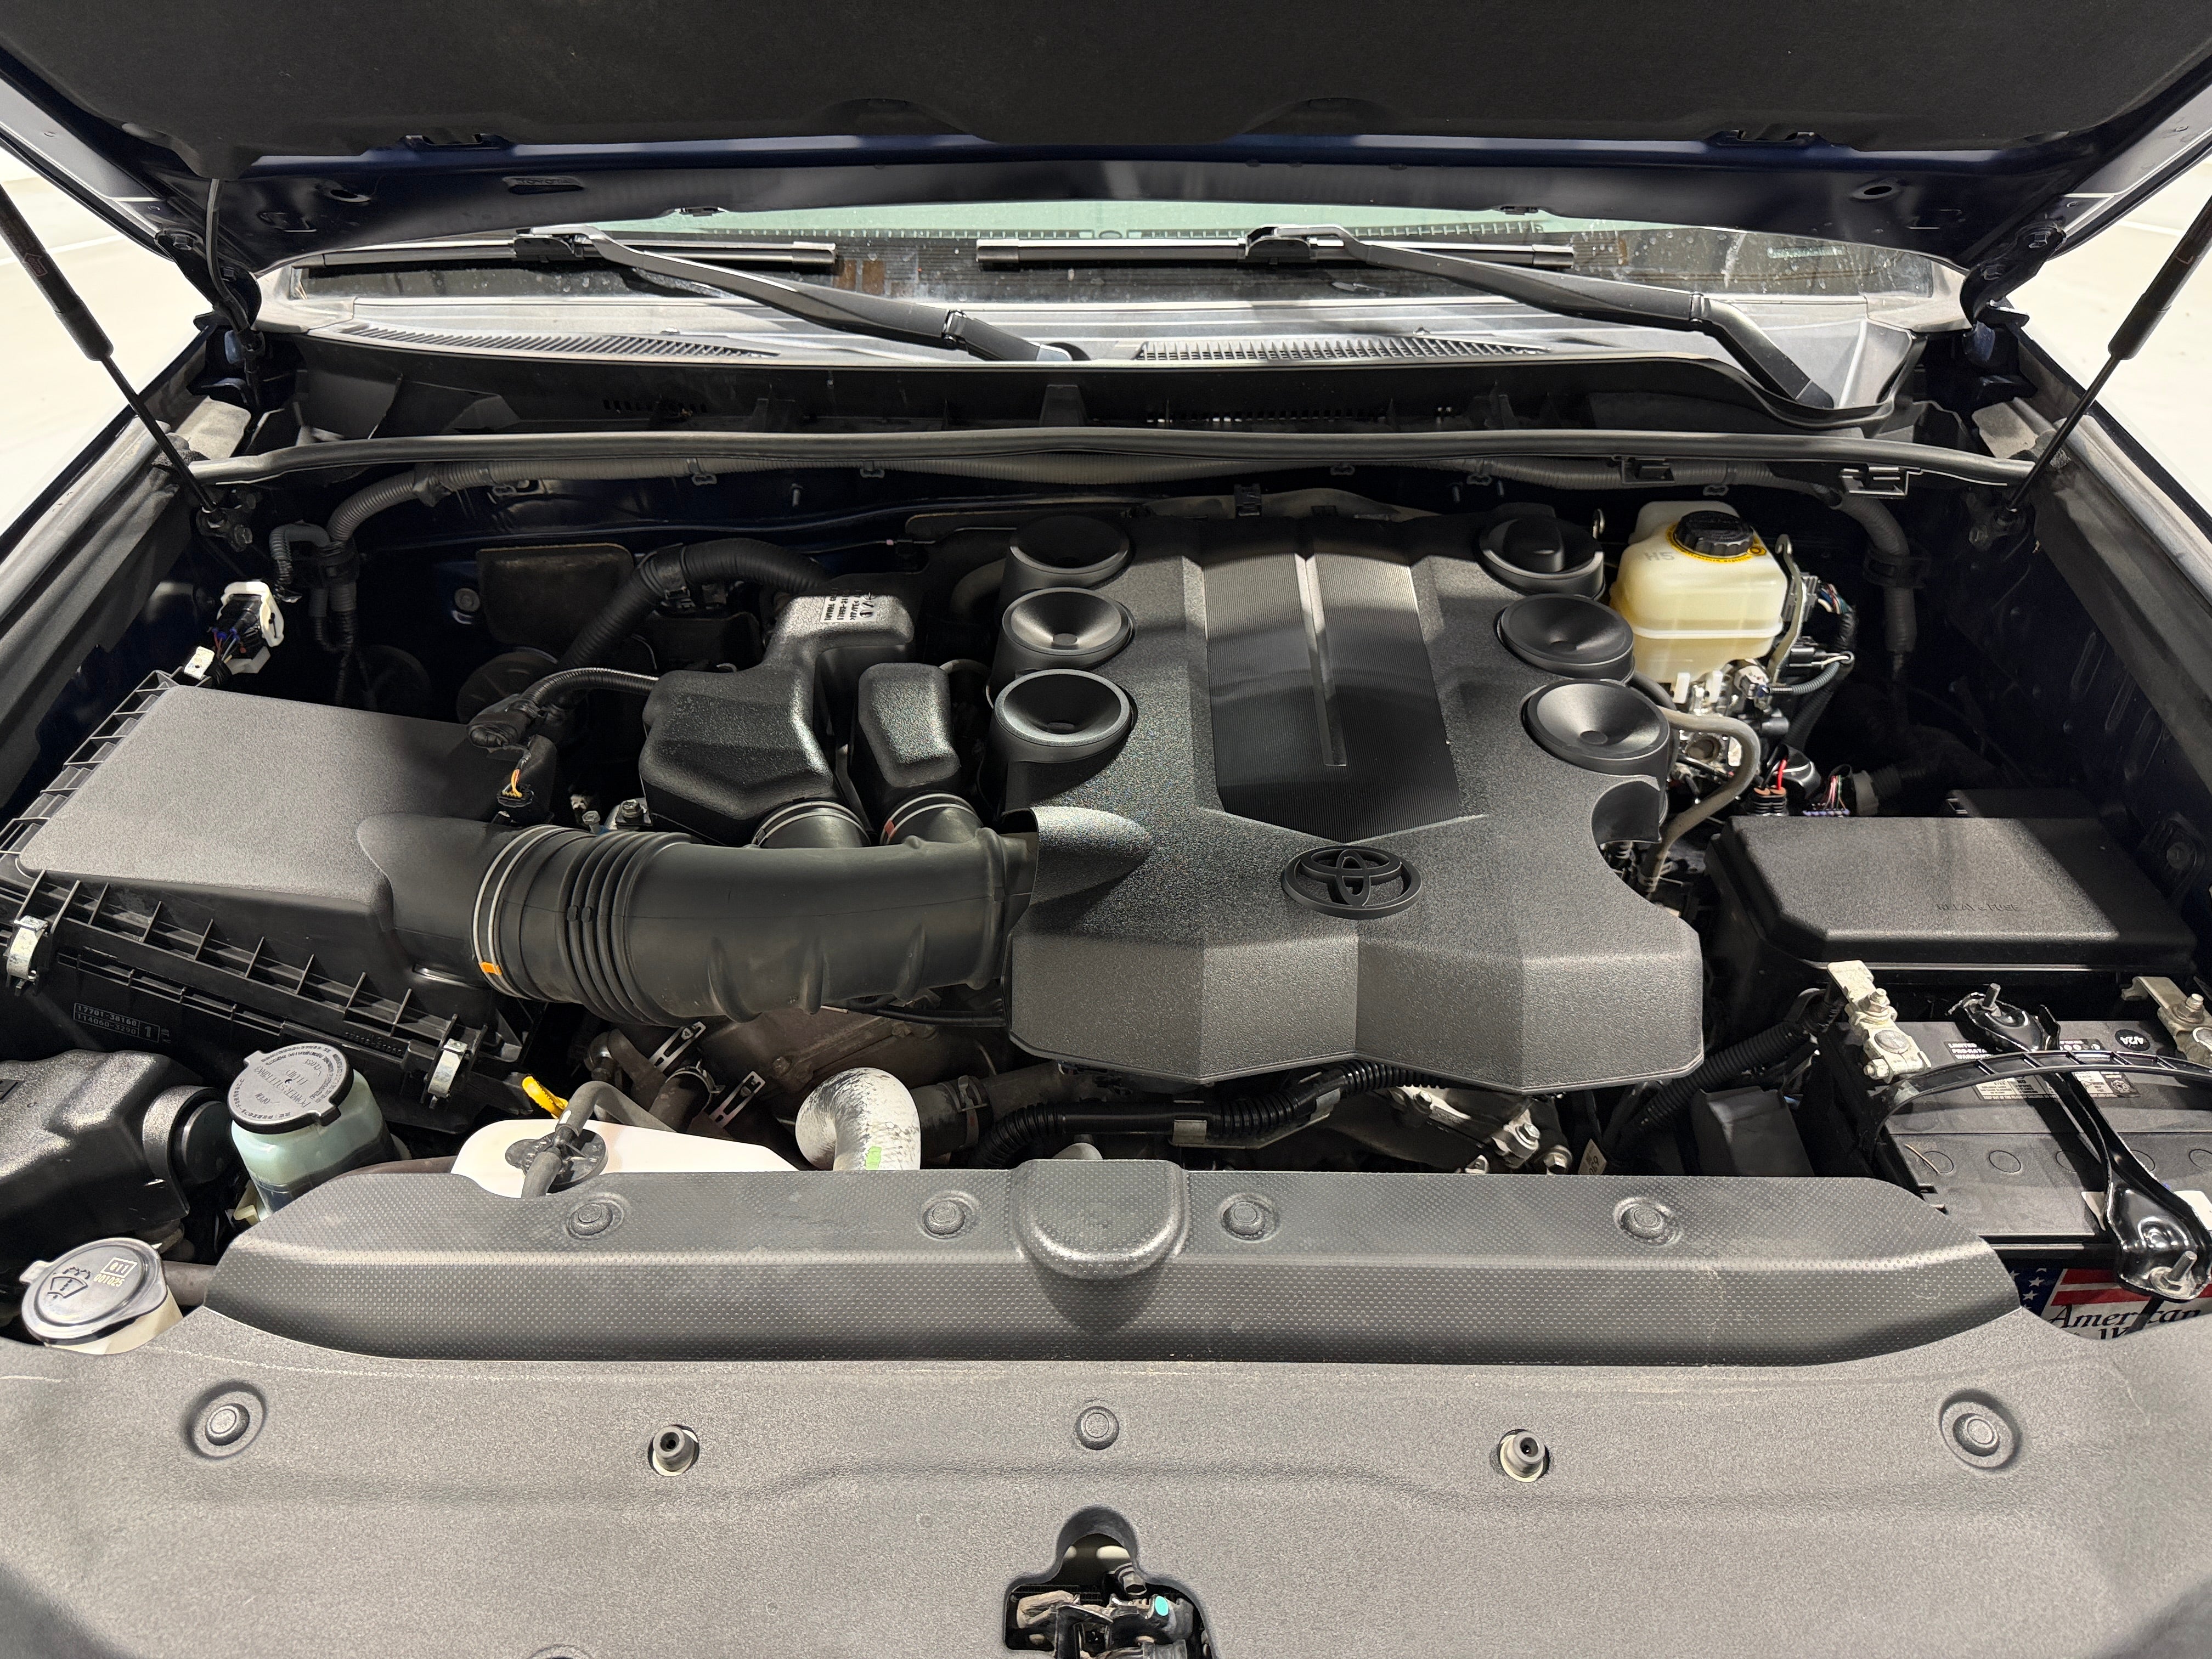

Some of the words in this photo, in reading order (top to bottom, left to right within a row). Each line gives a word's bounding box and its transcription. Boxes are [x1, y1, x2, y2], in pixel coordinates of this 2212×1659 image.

[1986, 903, 2022, 911] FUSE
[144, 1025, 151, 1038] 1
[93, 1273, 126, 1287] 001025
[2047, 1304, 2201, 1328] Amercan
